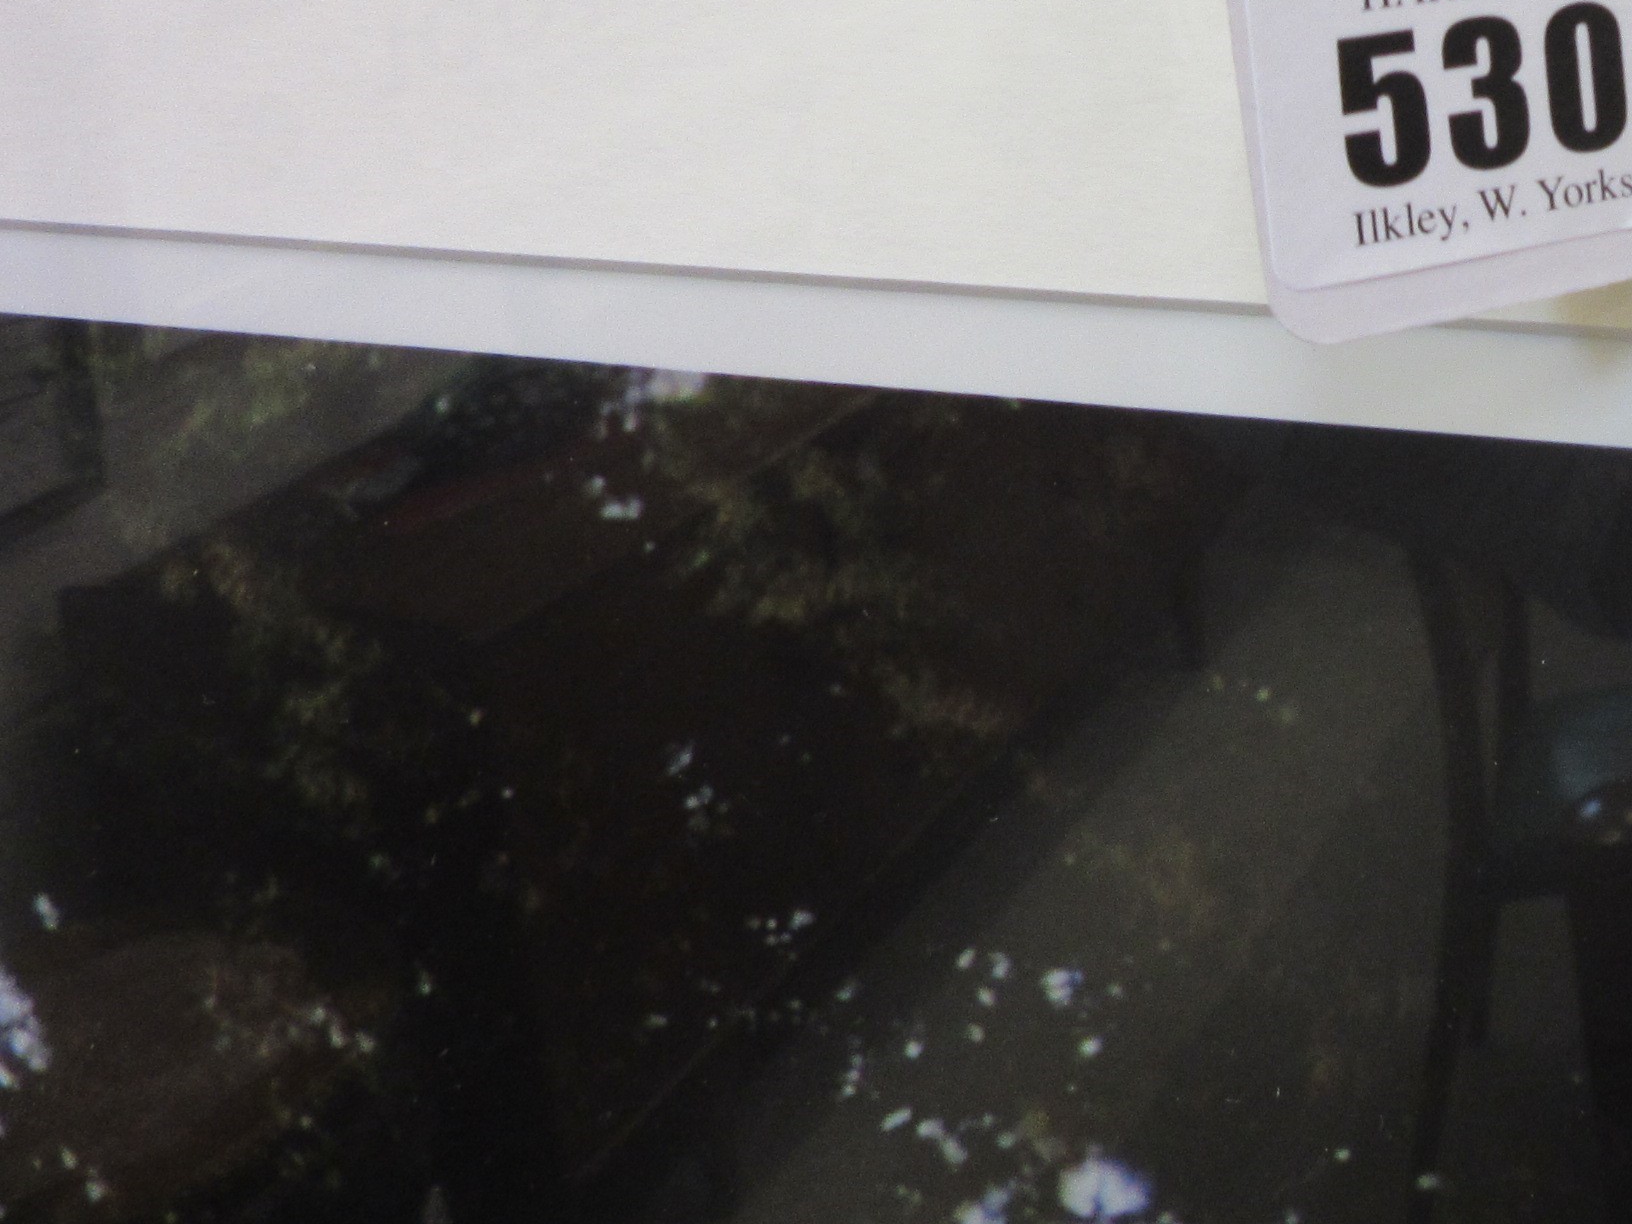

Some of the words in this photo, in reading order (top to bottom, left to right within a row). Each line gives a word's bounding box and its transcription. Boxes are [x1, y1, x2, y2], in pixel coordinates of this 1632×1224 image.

[1336, 1, 1628, 188] 530
[1353, 202, 1470, 249] Ilkley,
[1477, 184, 1528, 222] W.
